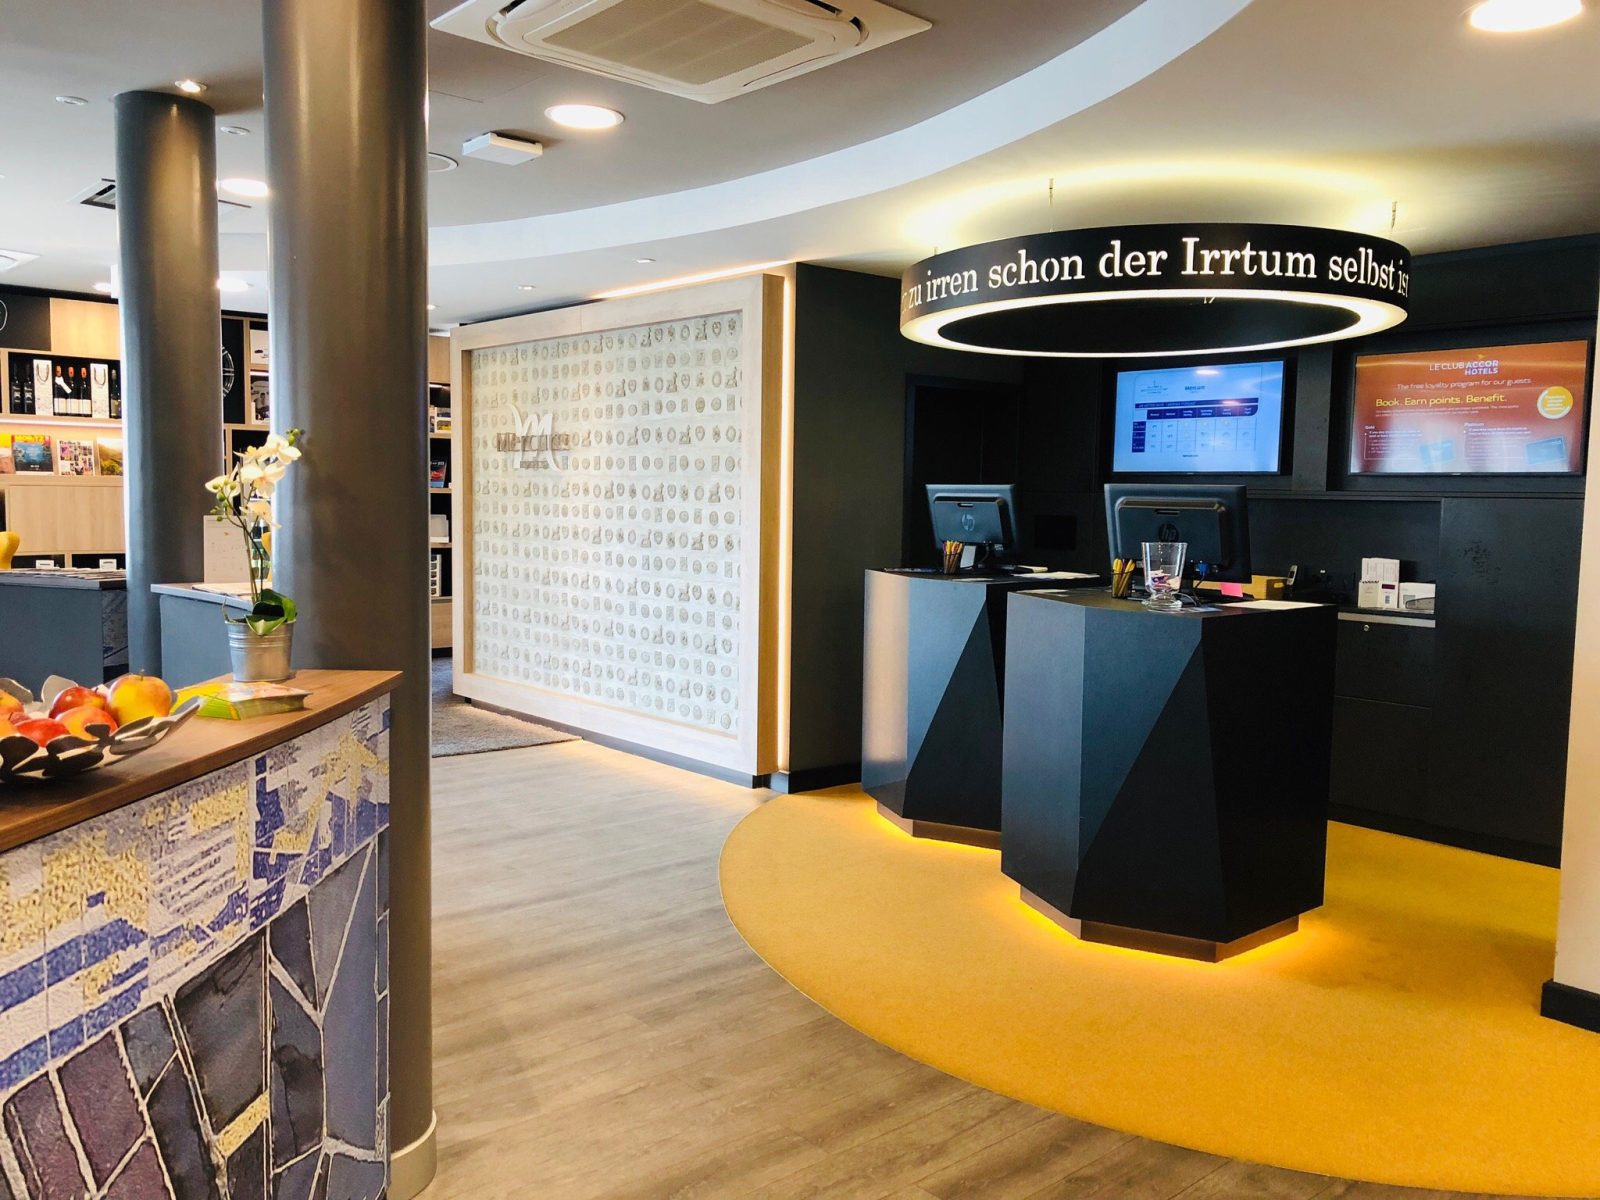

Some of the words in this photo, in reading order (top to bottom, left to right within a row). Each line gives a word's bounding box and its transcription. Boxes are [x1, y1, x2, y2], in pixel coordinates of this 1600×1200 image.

[908, 283, 922, 309] zu
[926, 269, 979, 302] irren
[988, 249, 1085, 289] schon
[1099, 239, 1168, 278] der
[1181, 237, 1317, 279] Irrtum
[1328, 246, 1395, 291] selbst
[1441, 361, 1464, 370] CLUB
[1465, 360, 1499, 369] ACCOR
[1464, 367, 1499, 376] HOTELS
[1404, 397, 1428, 407] Earn
